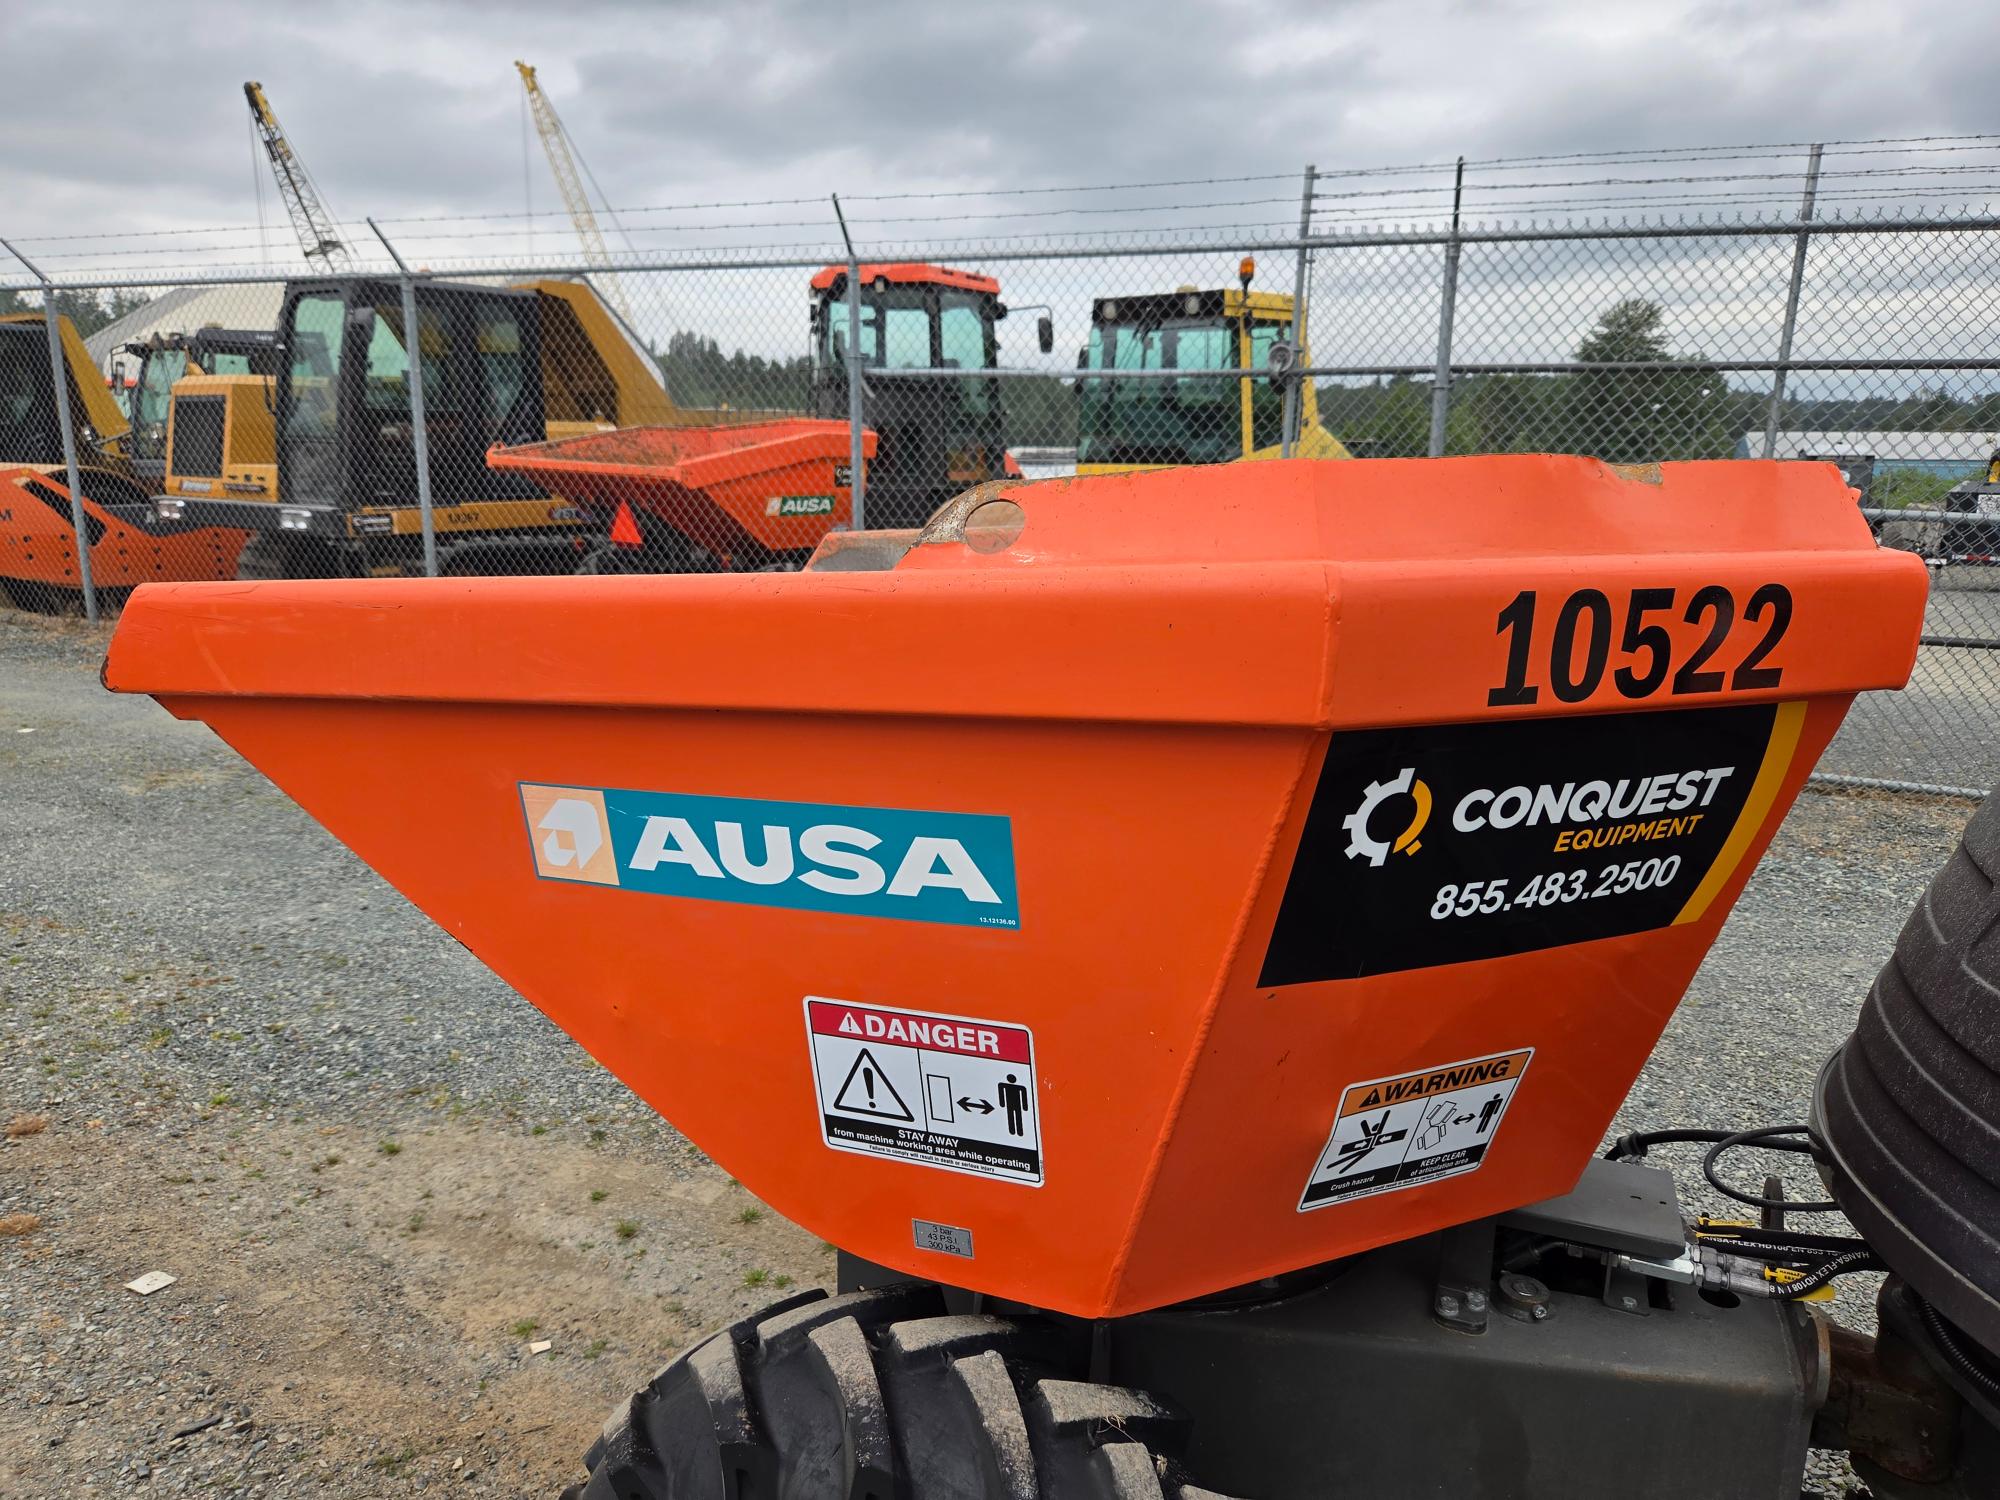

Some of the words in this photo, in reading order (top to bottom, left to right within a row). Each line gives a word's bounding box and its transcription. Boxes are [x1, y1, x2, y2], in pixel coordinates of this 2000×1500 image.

[781, 498, 832, 513] AUSA
[1487, 583, 1793, 707] 10522
[1452, 766, 1736, 833] CONQUEST
[1553, 814, 1704, 852] EQUIPMENT
[628, 815, 1003, 904] AUSA
[1430, 854, 1682, 920] 855.483.2500
[864, 1014, 1000, 1055] DANGER
[1384, 1059, 1511, 1102] WARNING
[898, 1129, 925, 1142] STAY
[927, 1133, 959, 1148] AWAY
[833, 1127, 854, 1138] from
[856, 1132, 894, 1145] machine
[896, 1140, 933, 1154] working
[935, 1146, 956, 1156] area
[958, 1150, 983, 1161] while
[985, 1155, 1031, 1171] operating
[869, 1144, 885, 1152] Failure
[892, 1148, 909, 1157] comply
[920, 1153, 934, 1161] result
[1418, 1161, 1454, 1175] articulation
[1454, 1158, 1469, 1166] area
[1420, 1156, 1441, 1168] KEEP
[1441, 1150, 1467, 1162] CLEAR
[1330, 1180, 1351, 1191] Crush
[1351, 1175, 1376, 1186] hazard
[927, 1233, 938, 1241] 43
[932, 1225, 938, 1233] 3
[940, 1227, 953, 1236] bar
[928, 1240, 943, 1250] 300
[945, 1244, 961, 1253] kPa
[1701, 1236, 1756, 1248] ANSA-FLEX
[1816, 1251, 1870, 1278] HANSA-FLEX
[1792, 1274, 1818, 1292] HD108
